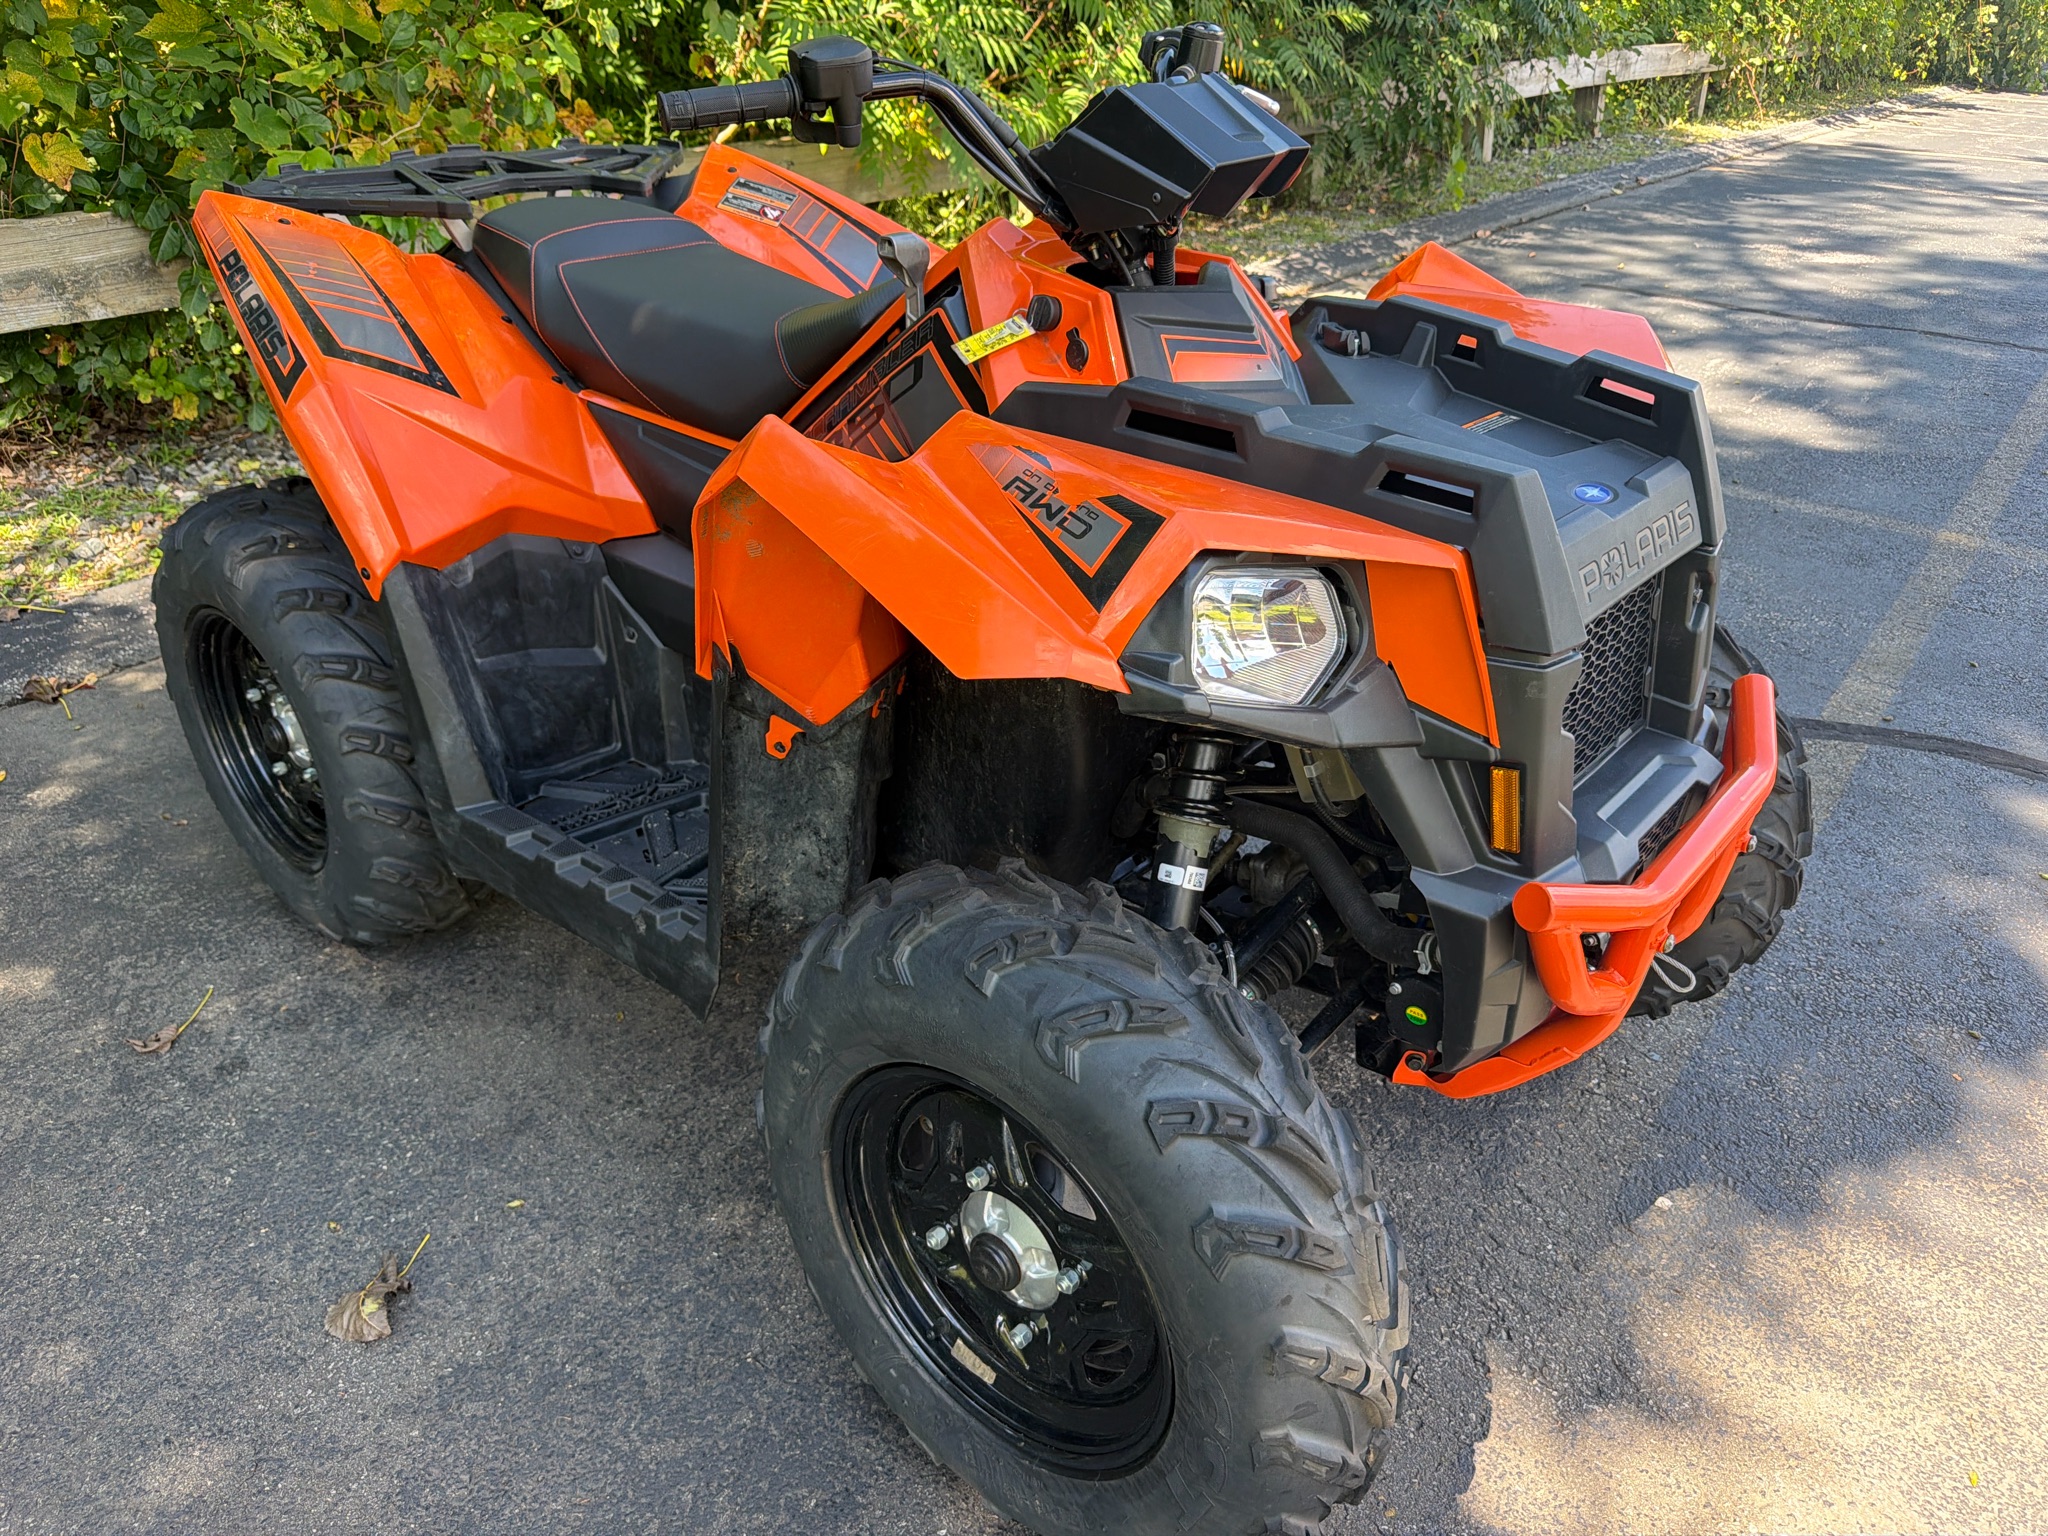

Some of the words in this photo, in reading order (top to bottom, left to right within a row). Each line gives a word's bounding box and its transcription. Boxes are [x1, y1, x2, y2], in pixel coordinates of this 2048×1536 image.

[217, 249, 287, 361] POLARIS
[805, 315, 934, 439] CRAMBLER
[1001, 475, 1093, 540] AWD
[1578, 500, 1695, 604] POLARIS
